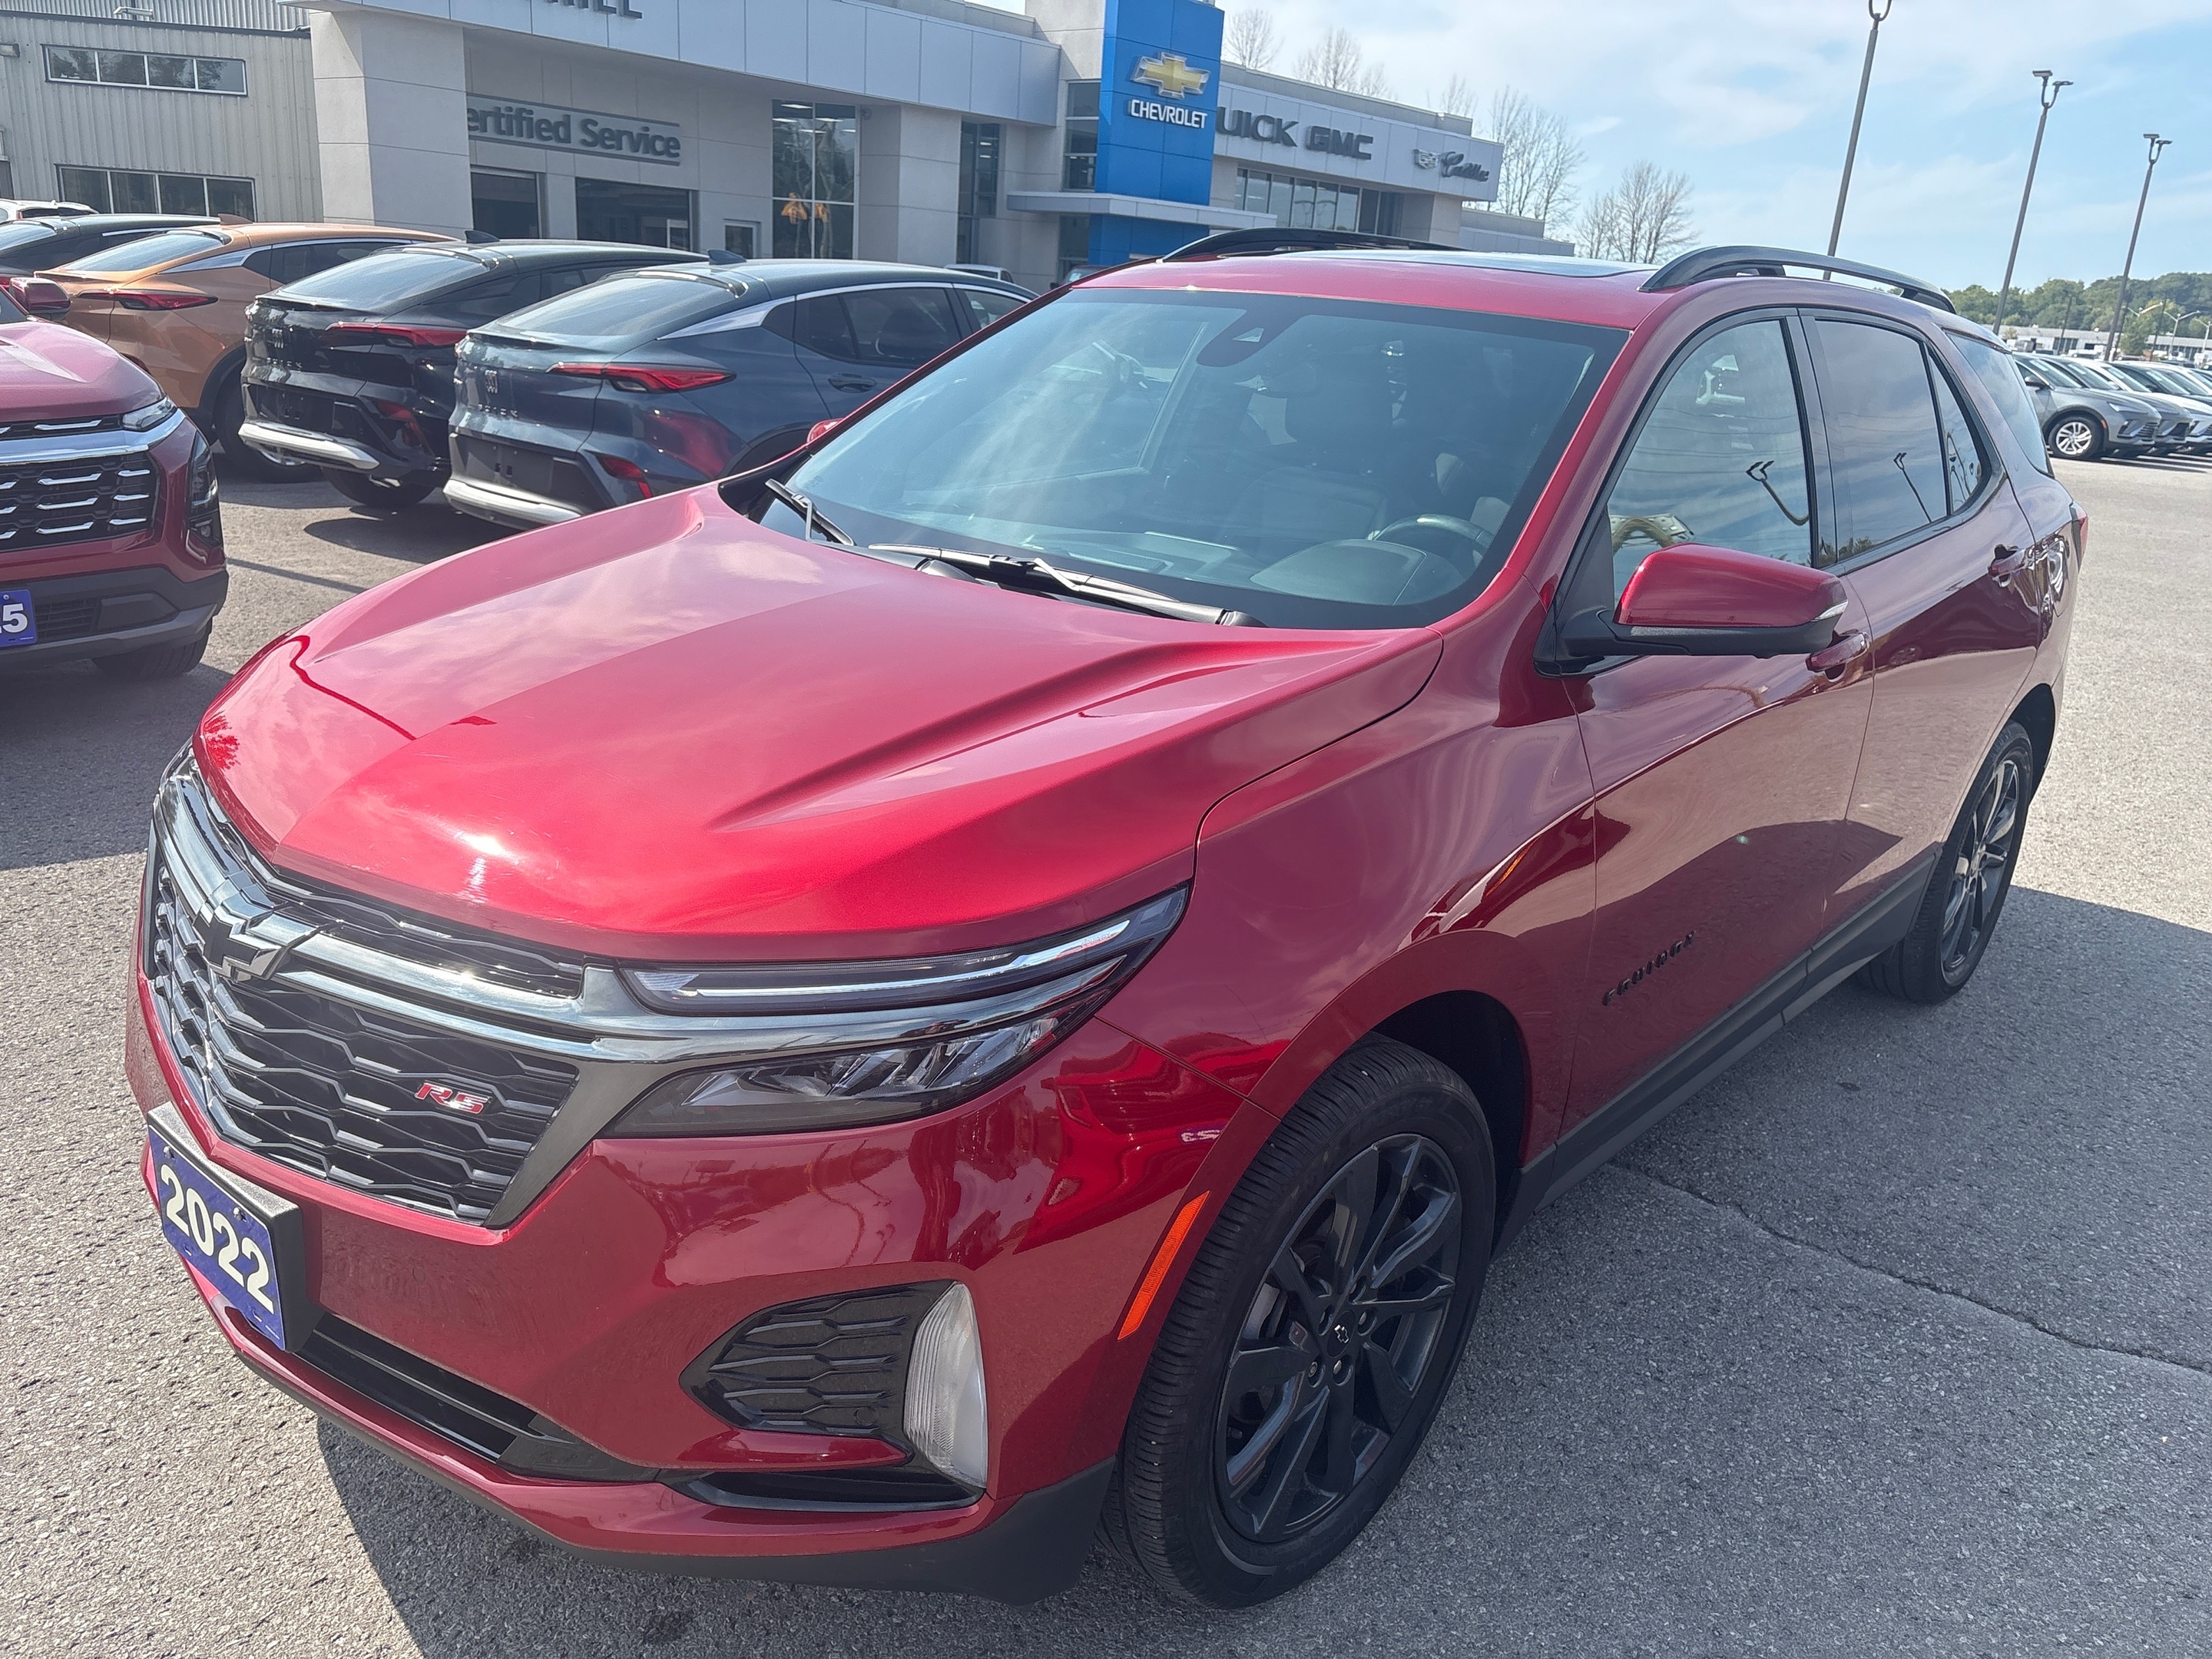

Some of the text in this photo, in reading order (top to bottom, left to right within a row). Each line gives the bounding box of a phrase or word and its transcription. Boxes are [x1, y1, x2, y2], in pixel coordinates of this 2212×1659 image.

[467, 106, 681, 158] ertified Service
[1131, 99, 1208, 129] CHEVROLET
[1216, 106, 1374, 161] UICK GMC
[0, 603, 28, 634] 5
[415, 1082, 492, 1114] RS
[161, 1164, 274, 1315] 2022
